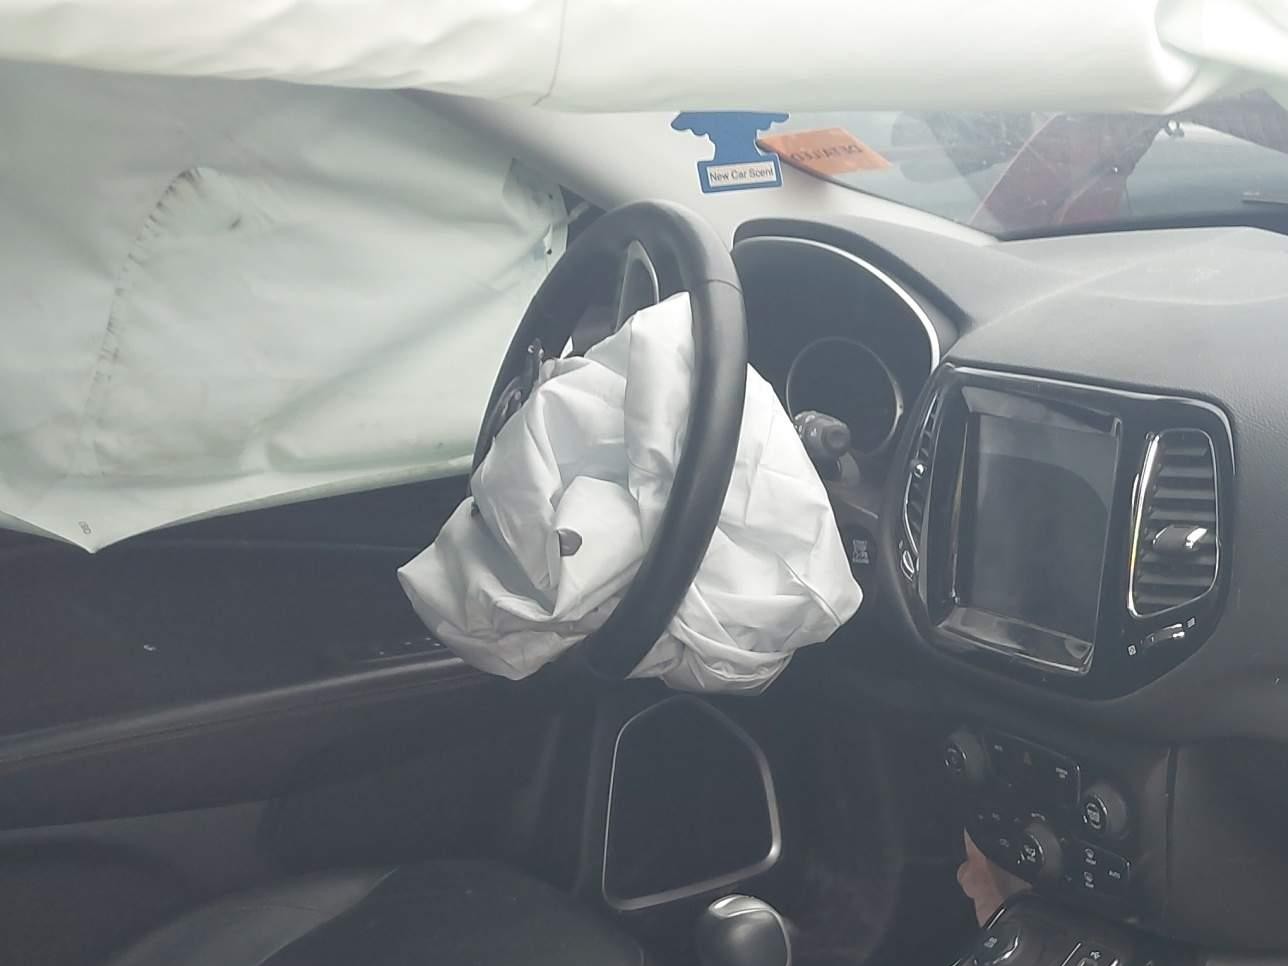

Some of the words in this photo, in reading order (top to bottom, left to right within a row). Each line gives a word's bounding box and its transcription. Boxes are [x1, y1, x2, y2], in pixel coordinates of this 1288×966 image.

[709, 171, 730, 182] New
[731, 169, 748, 180] Car
[749, 167, 775, 178] Scent
